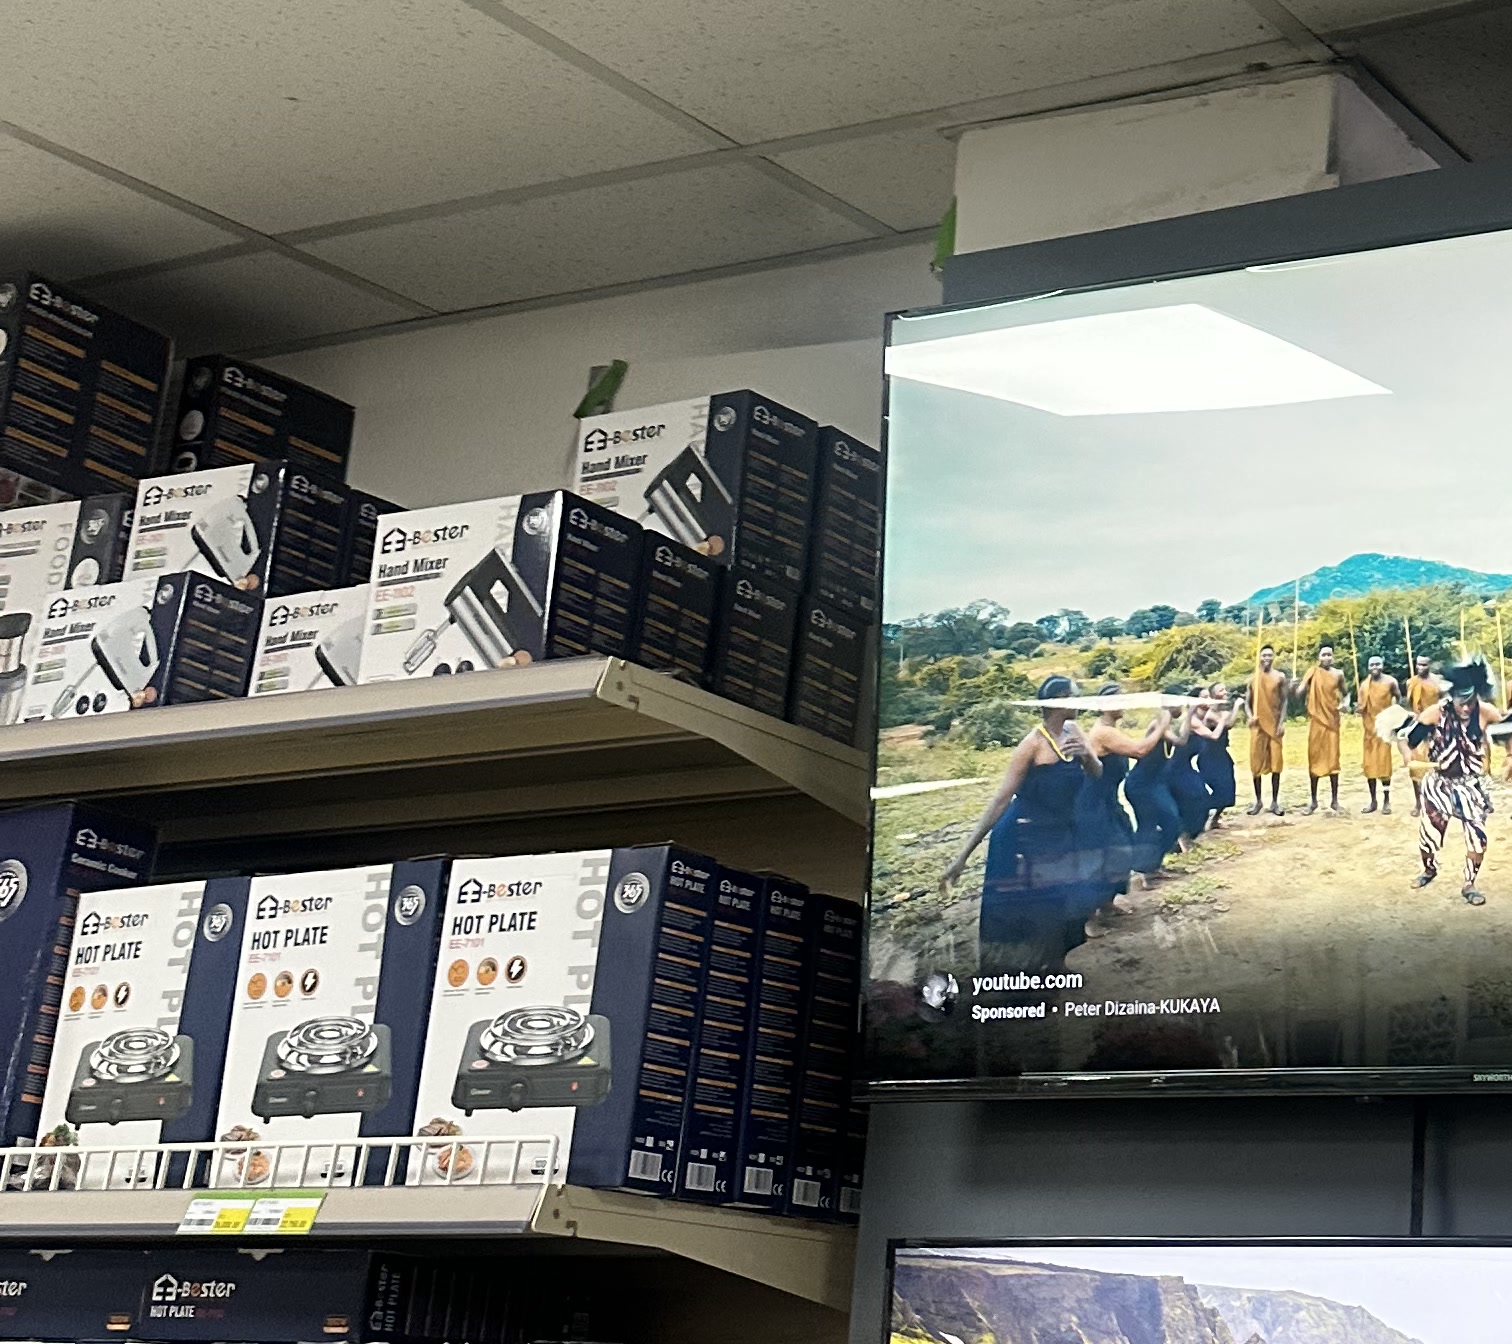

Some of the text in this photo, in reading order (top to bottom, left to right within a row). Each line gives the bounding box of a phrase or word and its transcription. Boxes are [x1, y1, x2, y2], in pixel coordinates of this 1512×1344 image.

[378, 557, 449, 578] Hand Mixer
[572, 858, 609, 948] HOT
[358, 872, 391, 959] HOT
[452, 911, 538, 935] HOT PLATE
[168, 890, 202, 973] HOT
[252, 926, 329, 950] HOT PLATE
[75, 941, 142, 965] HOT PLATE
[972, 972, 1083, 995] youtube.com
[971, 998, 1221, 1022] Sponsored Peter Dizaina-KUKAYA
[150, 1304, 195, 1318] HOT PLATE
